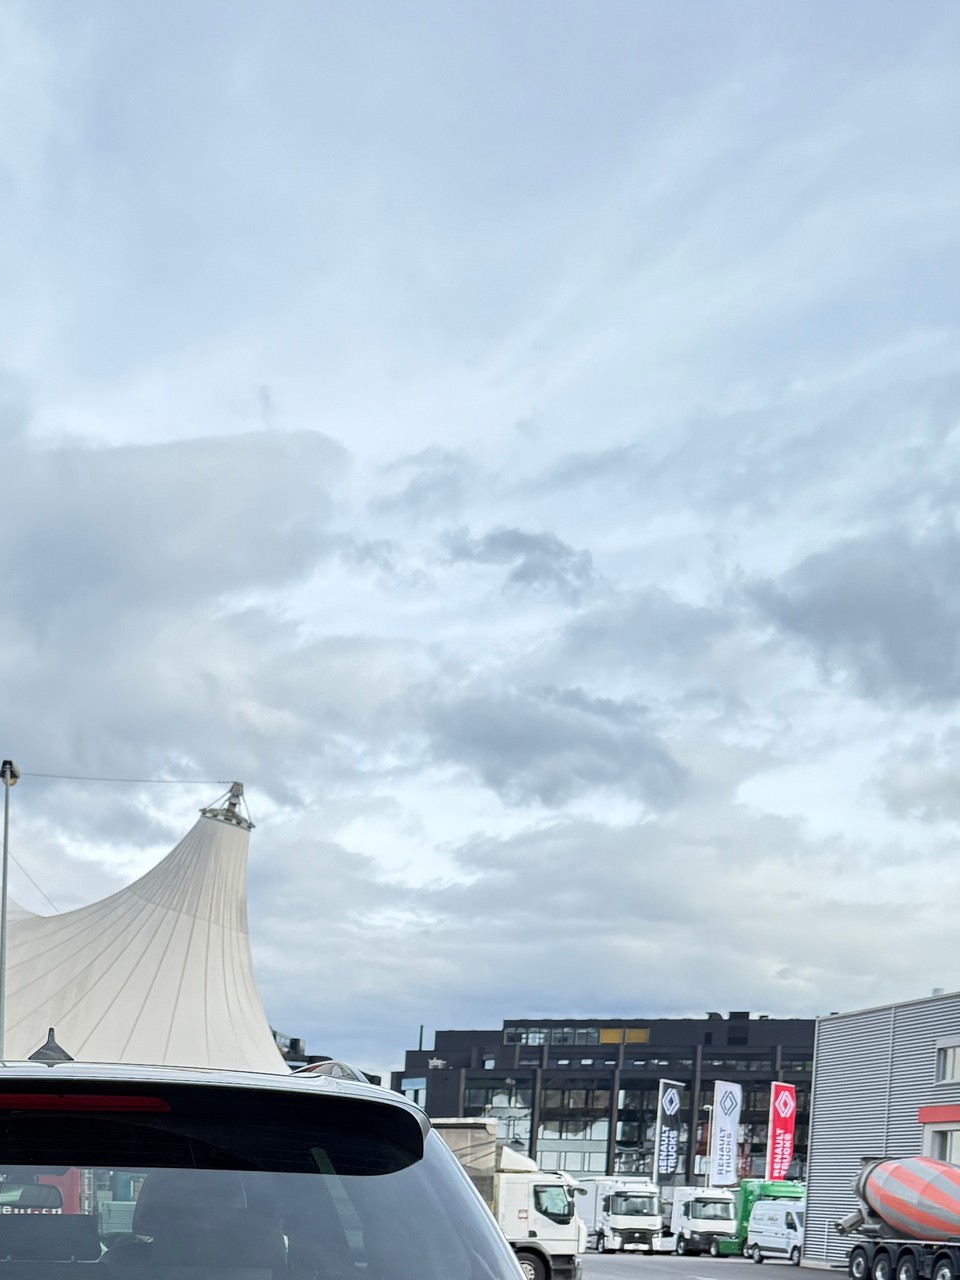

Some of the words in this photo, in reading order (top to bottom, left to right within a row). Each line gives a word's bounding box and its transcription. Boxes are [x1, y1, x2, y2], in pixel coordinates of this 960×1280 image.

[658, 1125, 670, 1174] RENAULT
[667, 1130, 678, 1174] TRUCKS
[717, 1127, 727, 1175] RENAULT
[725, 1132, 733, 1175] TRUCKS
[773, 1128, 785, 1177] RENAULT
[781, 1133, 792, 1177] TRUCKS
